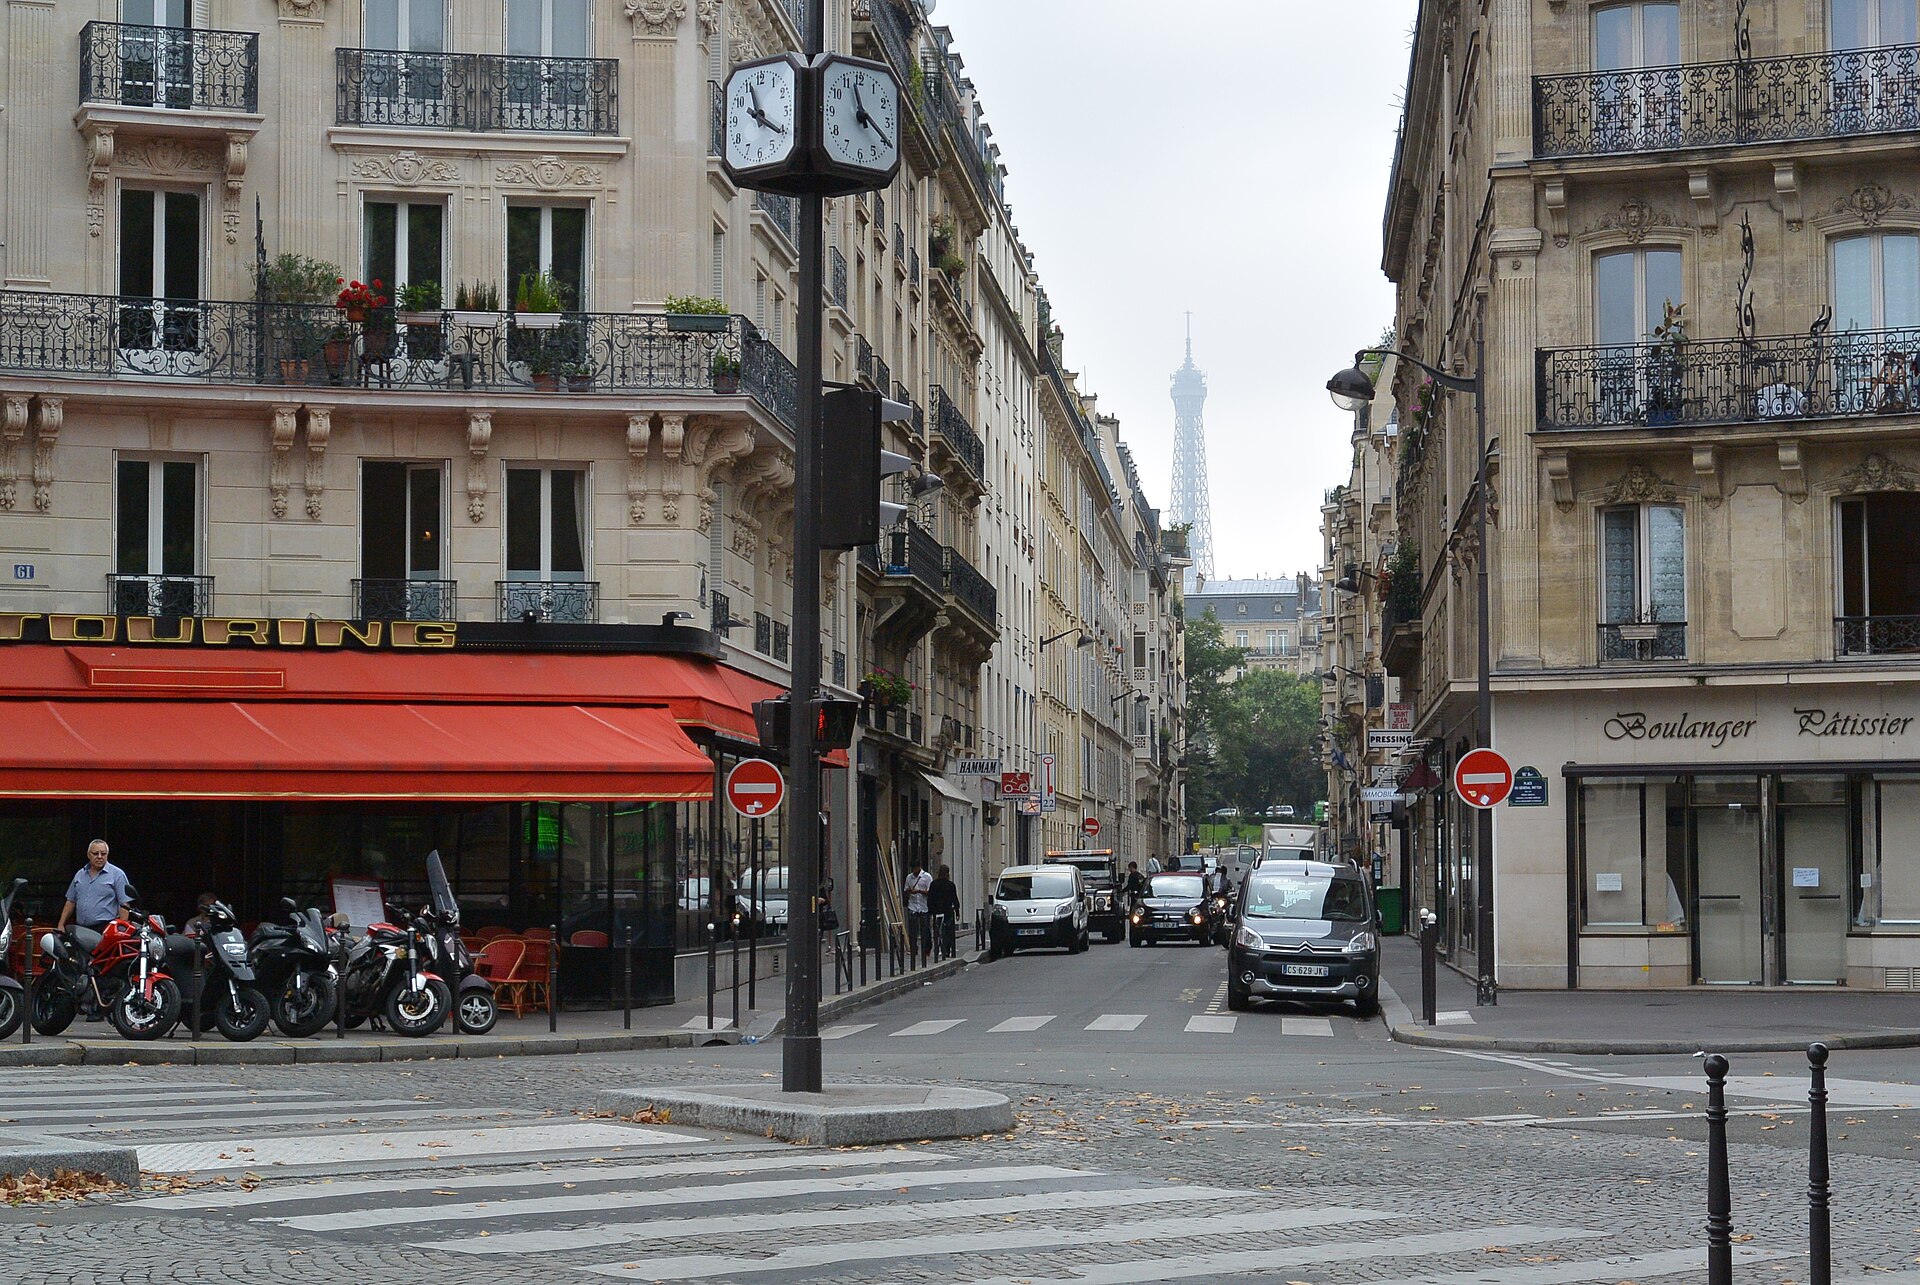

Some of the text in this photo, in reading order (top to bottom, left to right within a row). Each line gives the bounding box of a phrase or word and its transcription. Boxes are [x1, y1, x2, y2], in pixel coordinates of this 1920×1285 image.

[756, 73, 765, 86] 12
[772, 76, 776, 88] 1
[842, 78, 850, 89] 11
[855, 74, 864, 86] 12
[745, 81, 752, 94] 11
[780, 87, 786, 99] 2
[872, 83, 876, 94] 1
[833, 88, 842, 100] 10
[736, 96, 745, 108] 10
[880, 98, 886, 110] 2
[784, 105, 788, 117] 3
[830, 106, 836, 117] 9
[732, 116, 738, 128] 9
[884, 117, 890, 128] 3
[780, 124, 785, 136] 4
[834, 124, 840, 136] 8
[736, 133, 741, 144] 8
[745, 144, 751, 156] 7
[769, 140, 775, 151] 5
[844, 139, 850, 151] 7
[870, 145, 876, 156] 5
[757, 147, 762, 158] 6
[857, 148, 863, 160] 6
[16, 565, 31, 579] 61
[0, 613, 457, 648] TOURING
[1603, 706, 1914, 749] Boulanger Pâtissier
[1370, 735, 1412, 744] PRESSING
[959, 761, 998, 774] HAMMAM
[1042, 799, 1054, 808] 22
